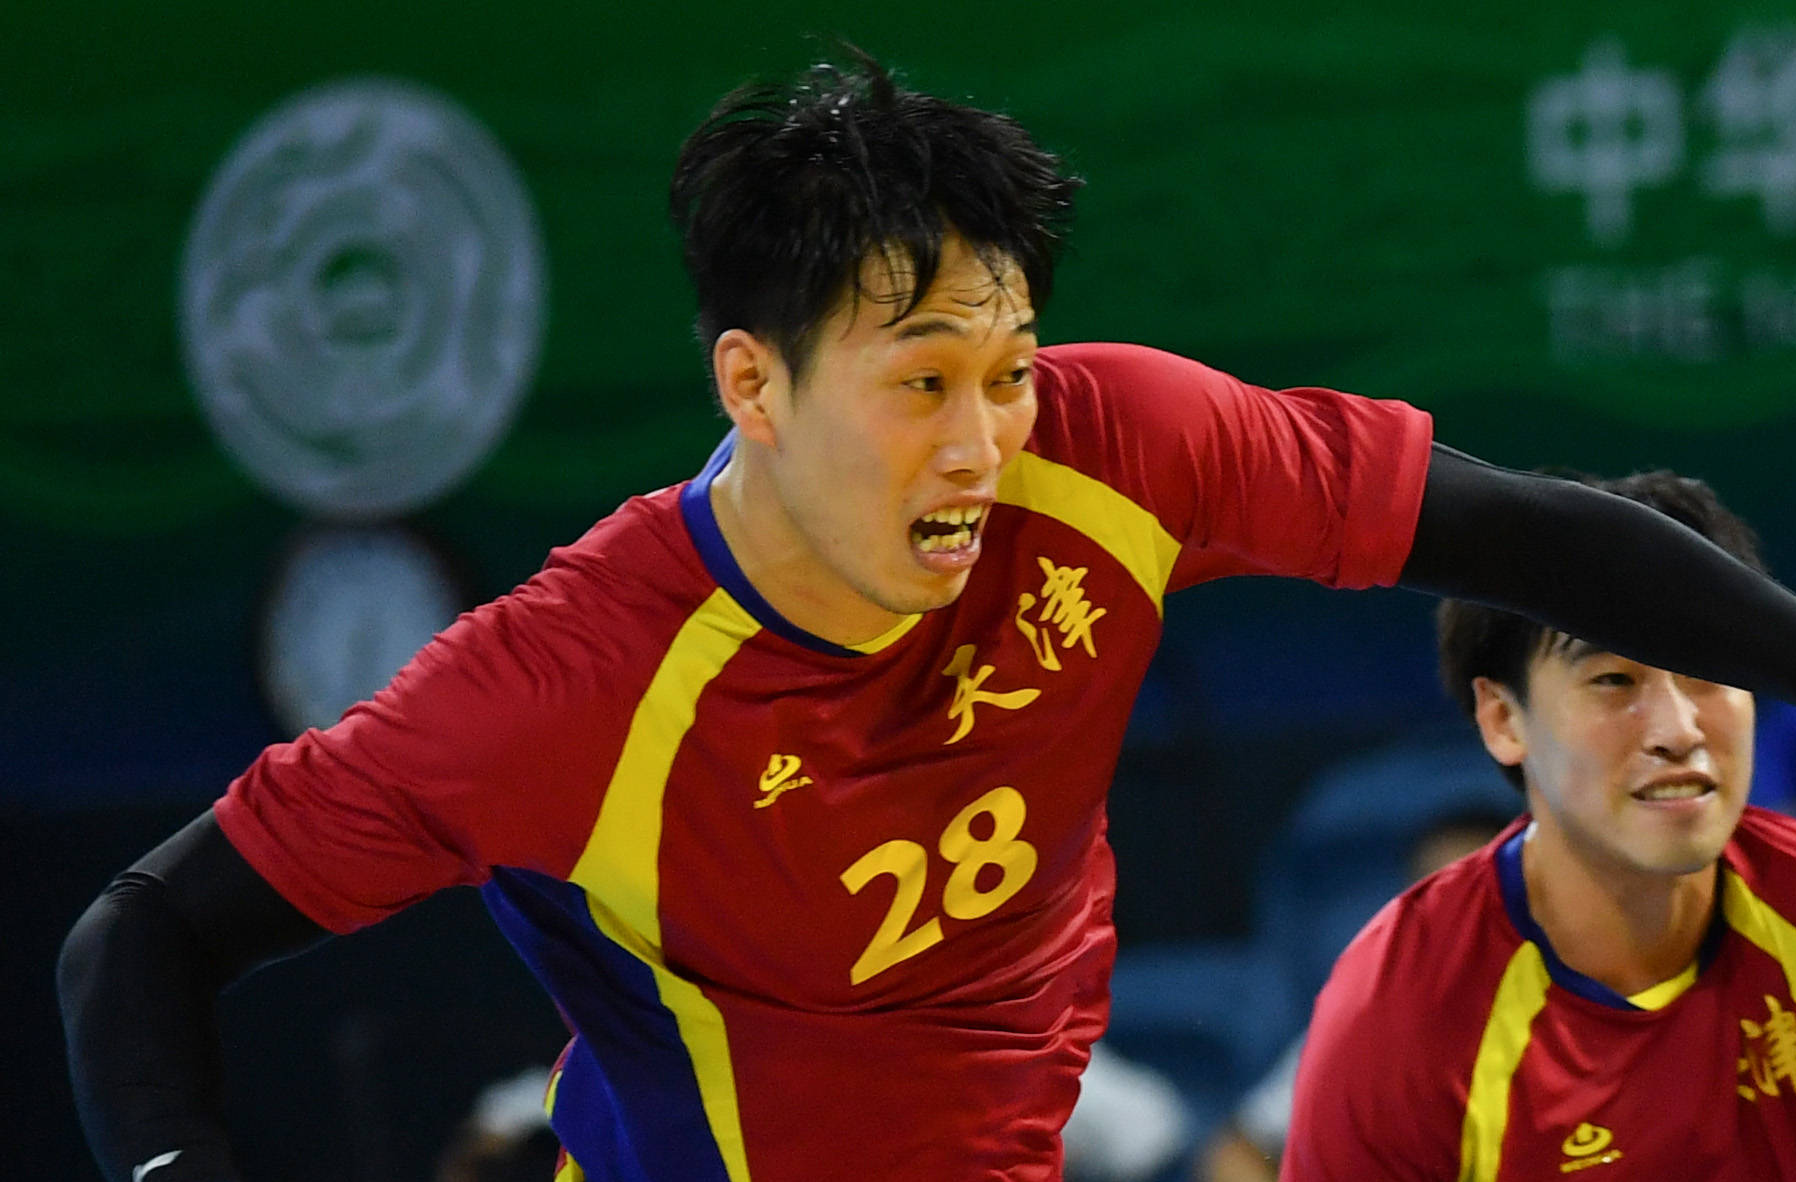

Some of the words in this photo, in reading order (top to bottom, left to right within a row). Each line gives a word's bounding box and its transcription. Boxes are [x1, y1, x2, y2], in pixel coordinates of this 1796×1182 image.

[1543, 258, 1720, 360] THE
[942, 556, 1107, 746] 天津
[839, 786, 1038, 986] 28
